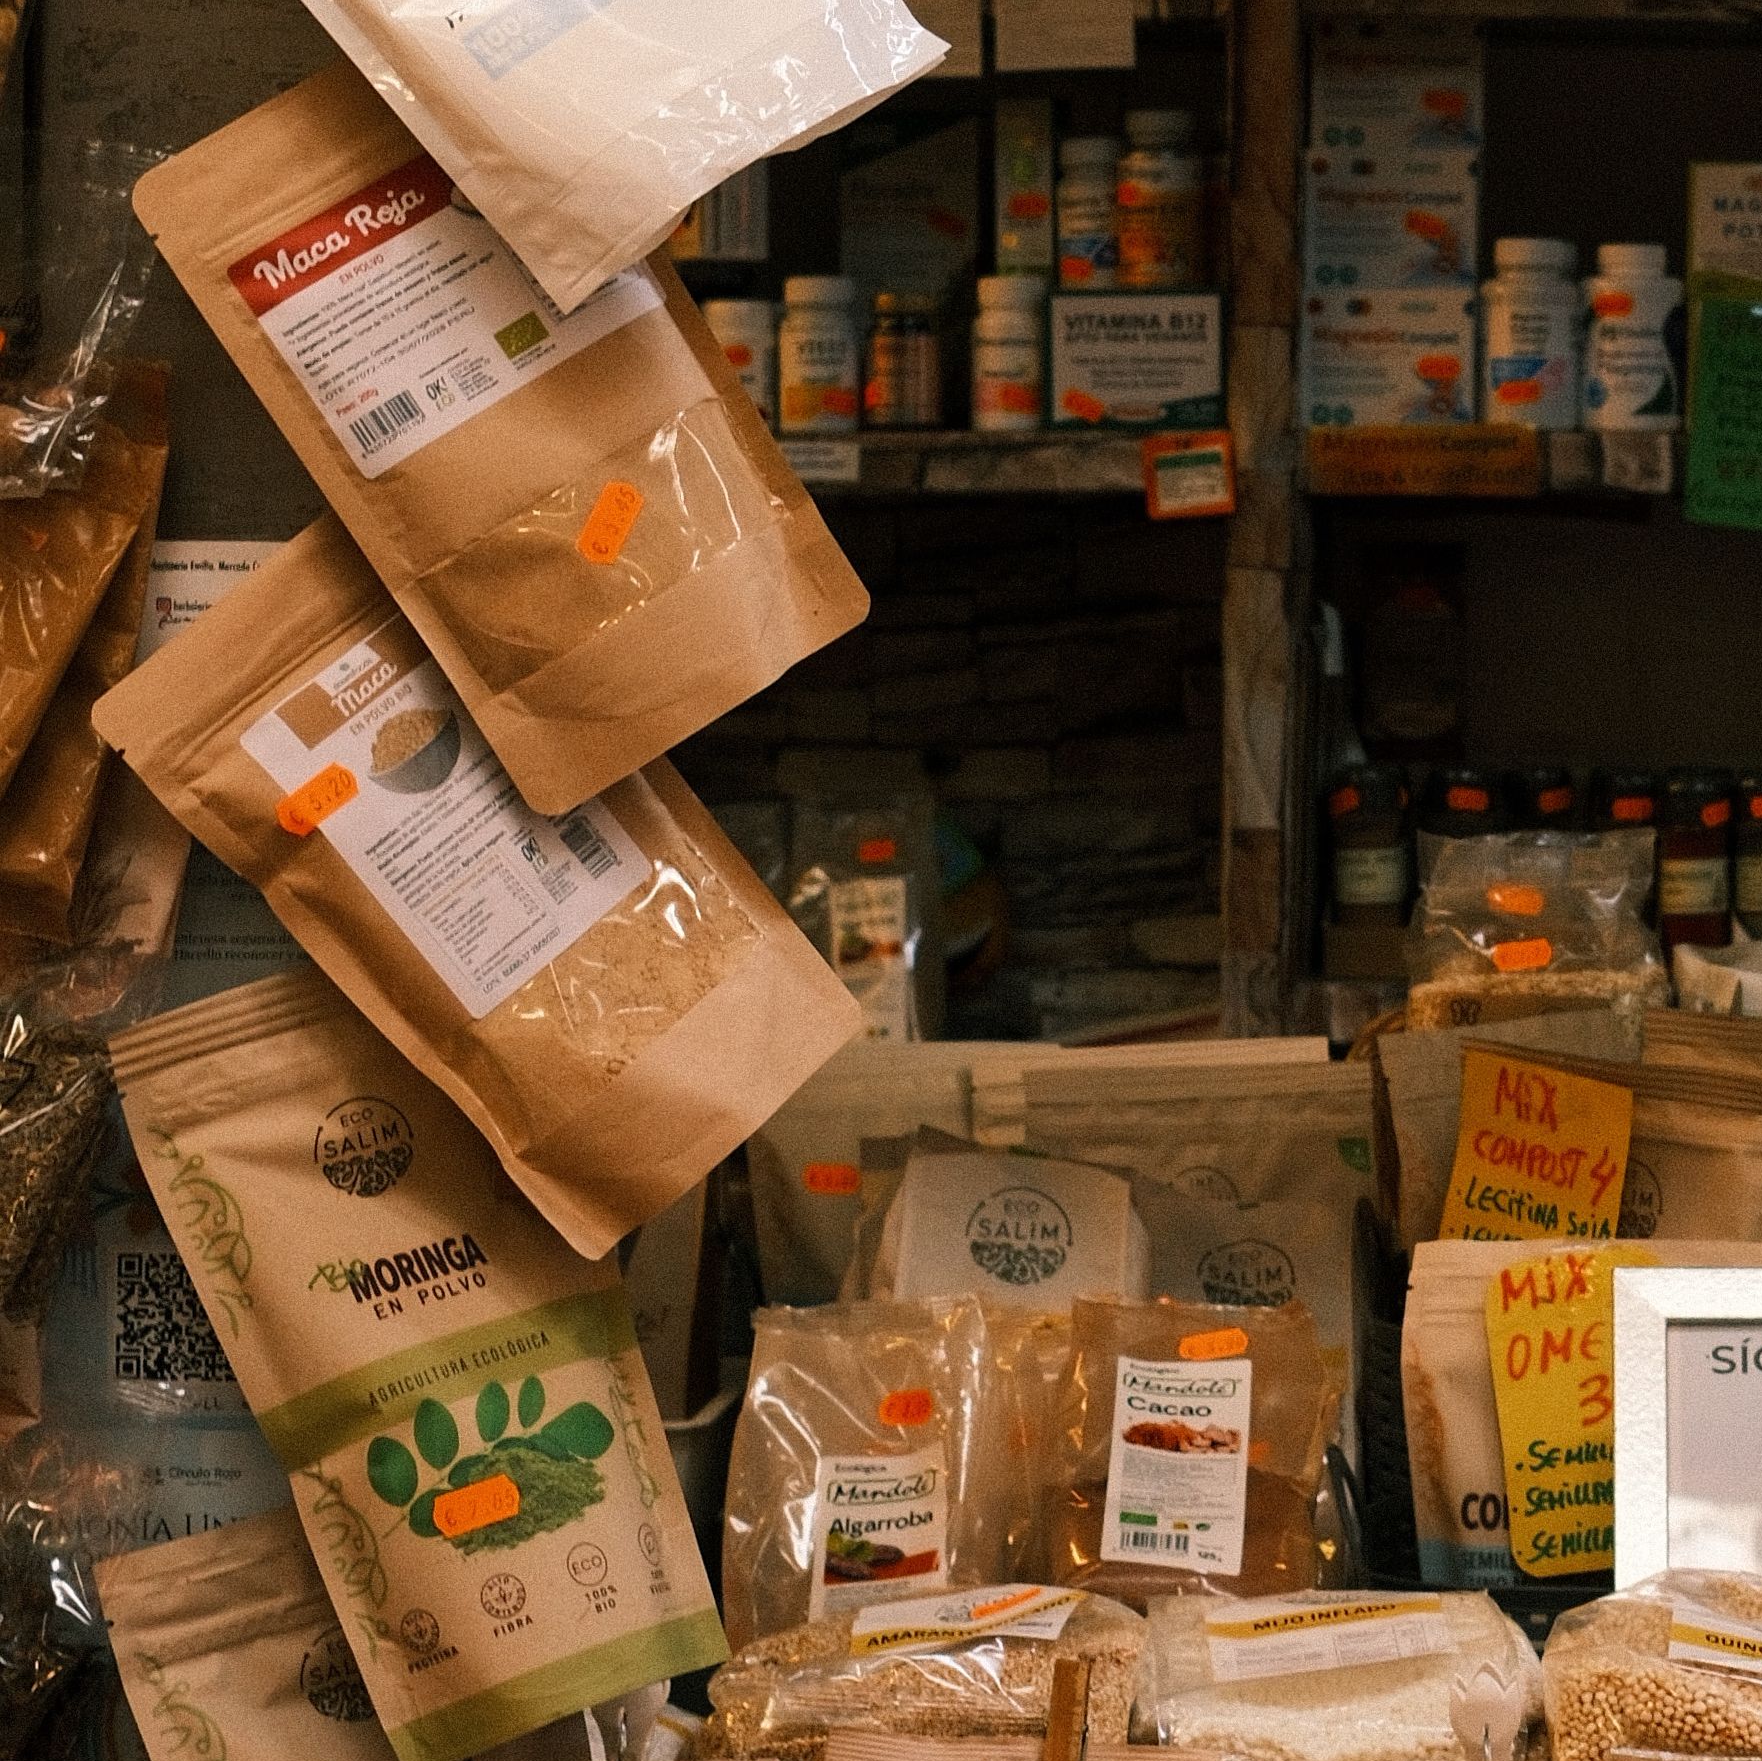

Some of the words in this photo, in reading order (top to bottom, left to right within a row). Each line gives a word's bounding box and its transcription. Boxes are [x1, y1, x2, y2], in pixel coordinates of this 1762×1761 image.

[253, 231, 353, 291] Maca
[344, 185, 427, 239] Roja
[330, 661, 399, 717] Maca
[340, 1107, 375, 1128] ECO
[323, 1120, 401, 1159] SALIM
[977, 1218, 1061, 1241] SALIM
[348, 1232, 489, 1305] MORINGA
[372, 1297, 404, 1321] EN
[417, 1271, 488, 1306] POLVO
[1126, 1396, 1213, 1419] Cacao
[827, 1508, 935, 1538] Algarroba
[571, 1554, 604, 1576] ECO
